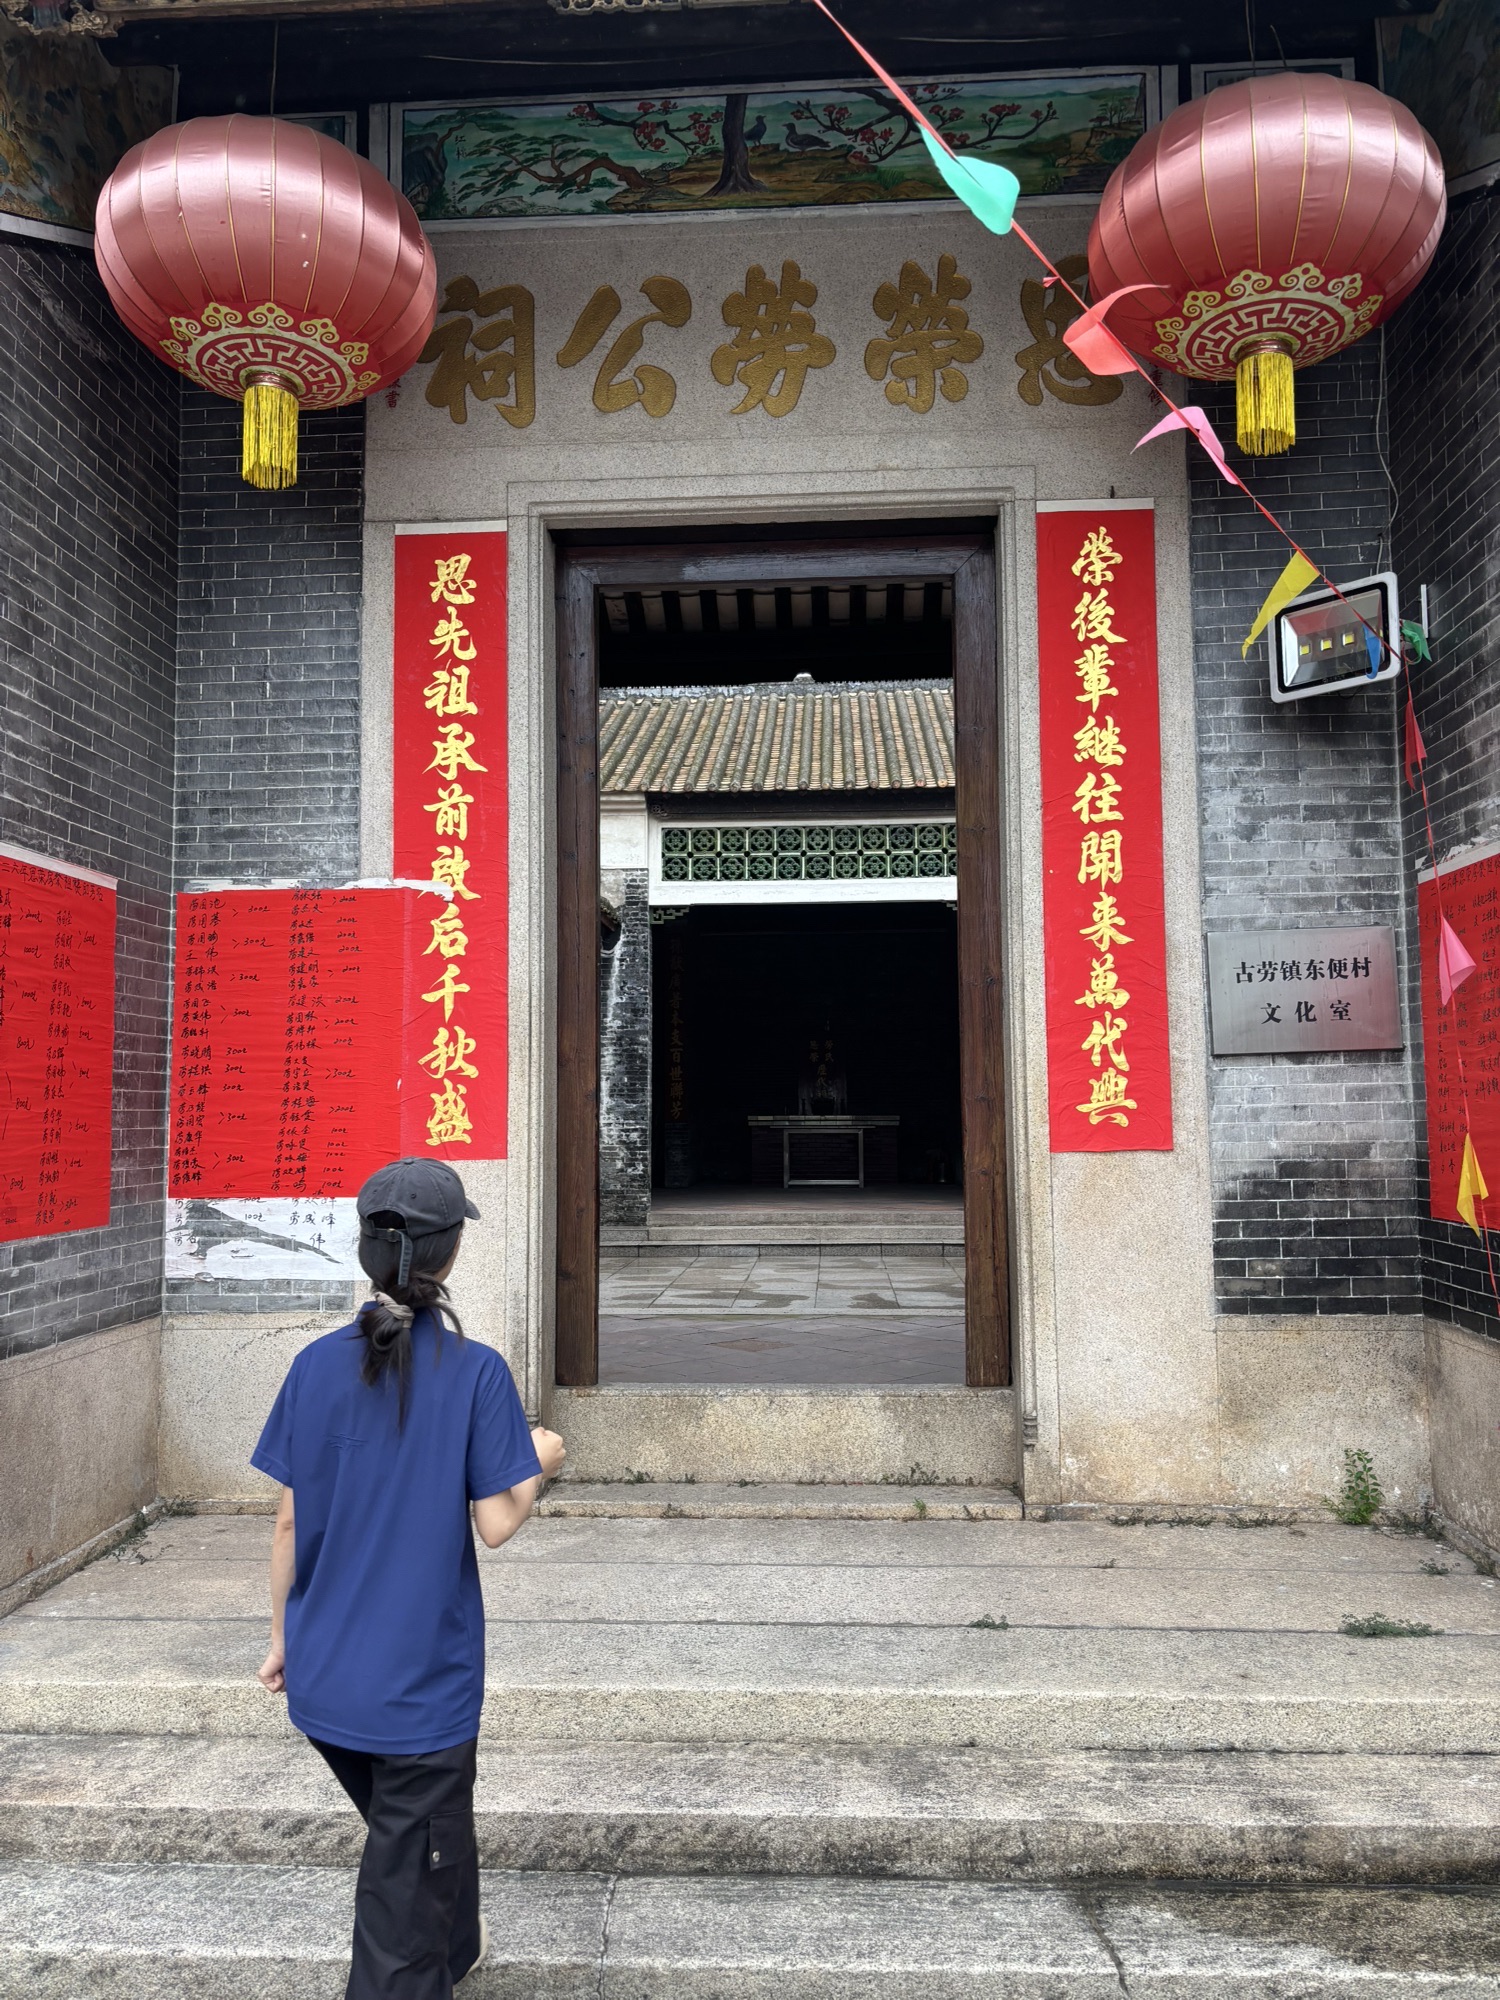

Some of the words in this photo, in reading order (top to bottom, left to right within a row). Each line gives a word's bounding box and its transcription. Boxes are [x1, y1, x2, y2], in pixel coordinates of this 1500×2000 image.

[1232, 956, 1373, 984] 古劳镇东便村
[1260, 1000, 1352, 1025] 文化室
